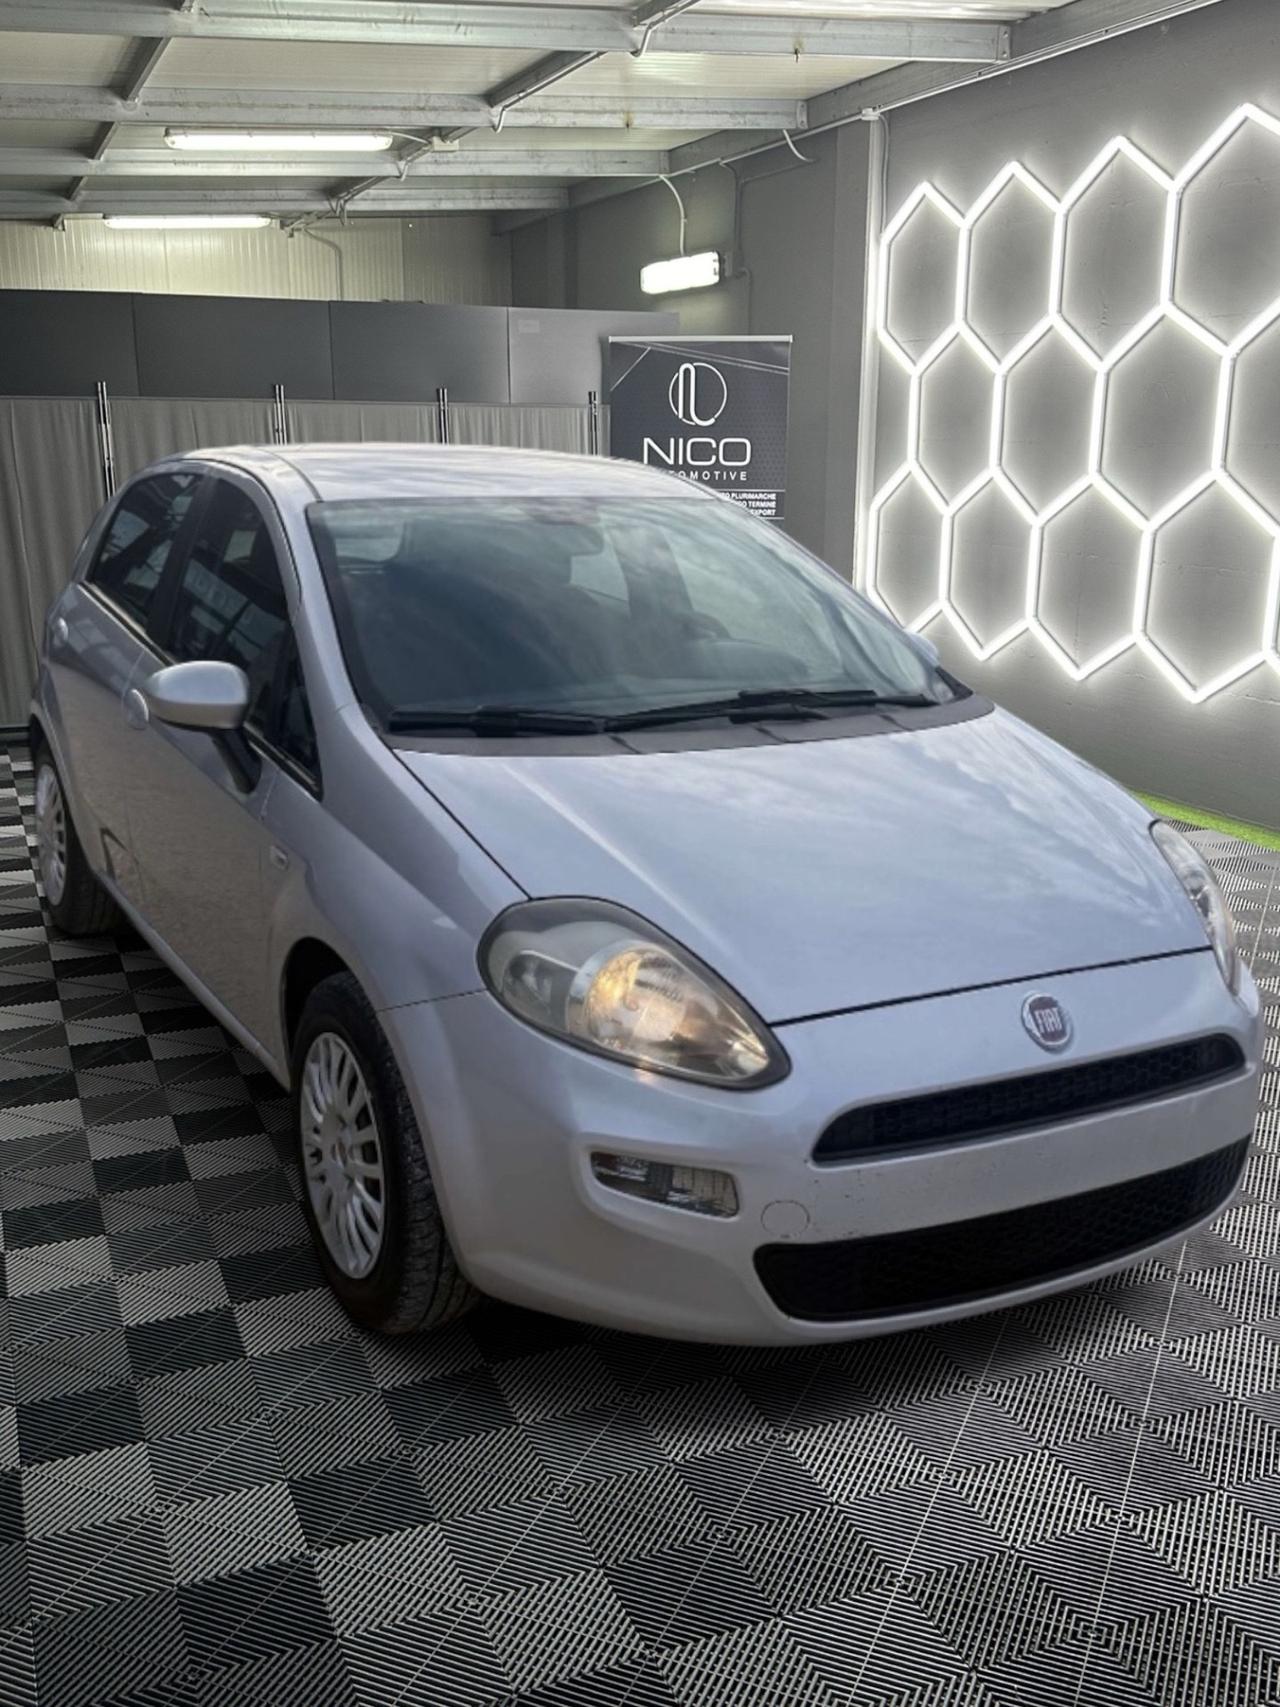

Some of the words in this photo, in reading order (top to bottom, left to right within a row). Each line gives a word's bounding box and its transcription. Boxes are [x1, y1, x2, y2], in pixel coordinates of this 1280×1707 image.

[643, 437, 752, 466] NICO
[669, 470, 747, 481] OMOTIVE
[1034, 1007, 1063, 1033] FIAT
